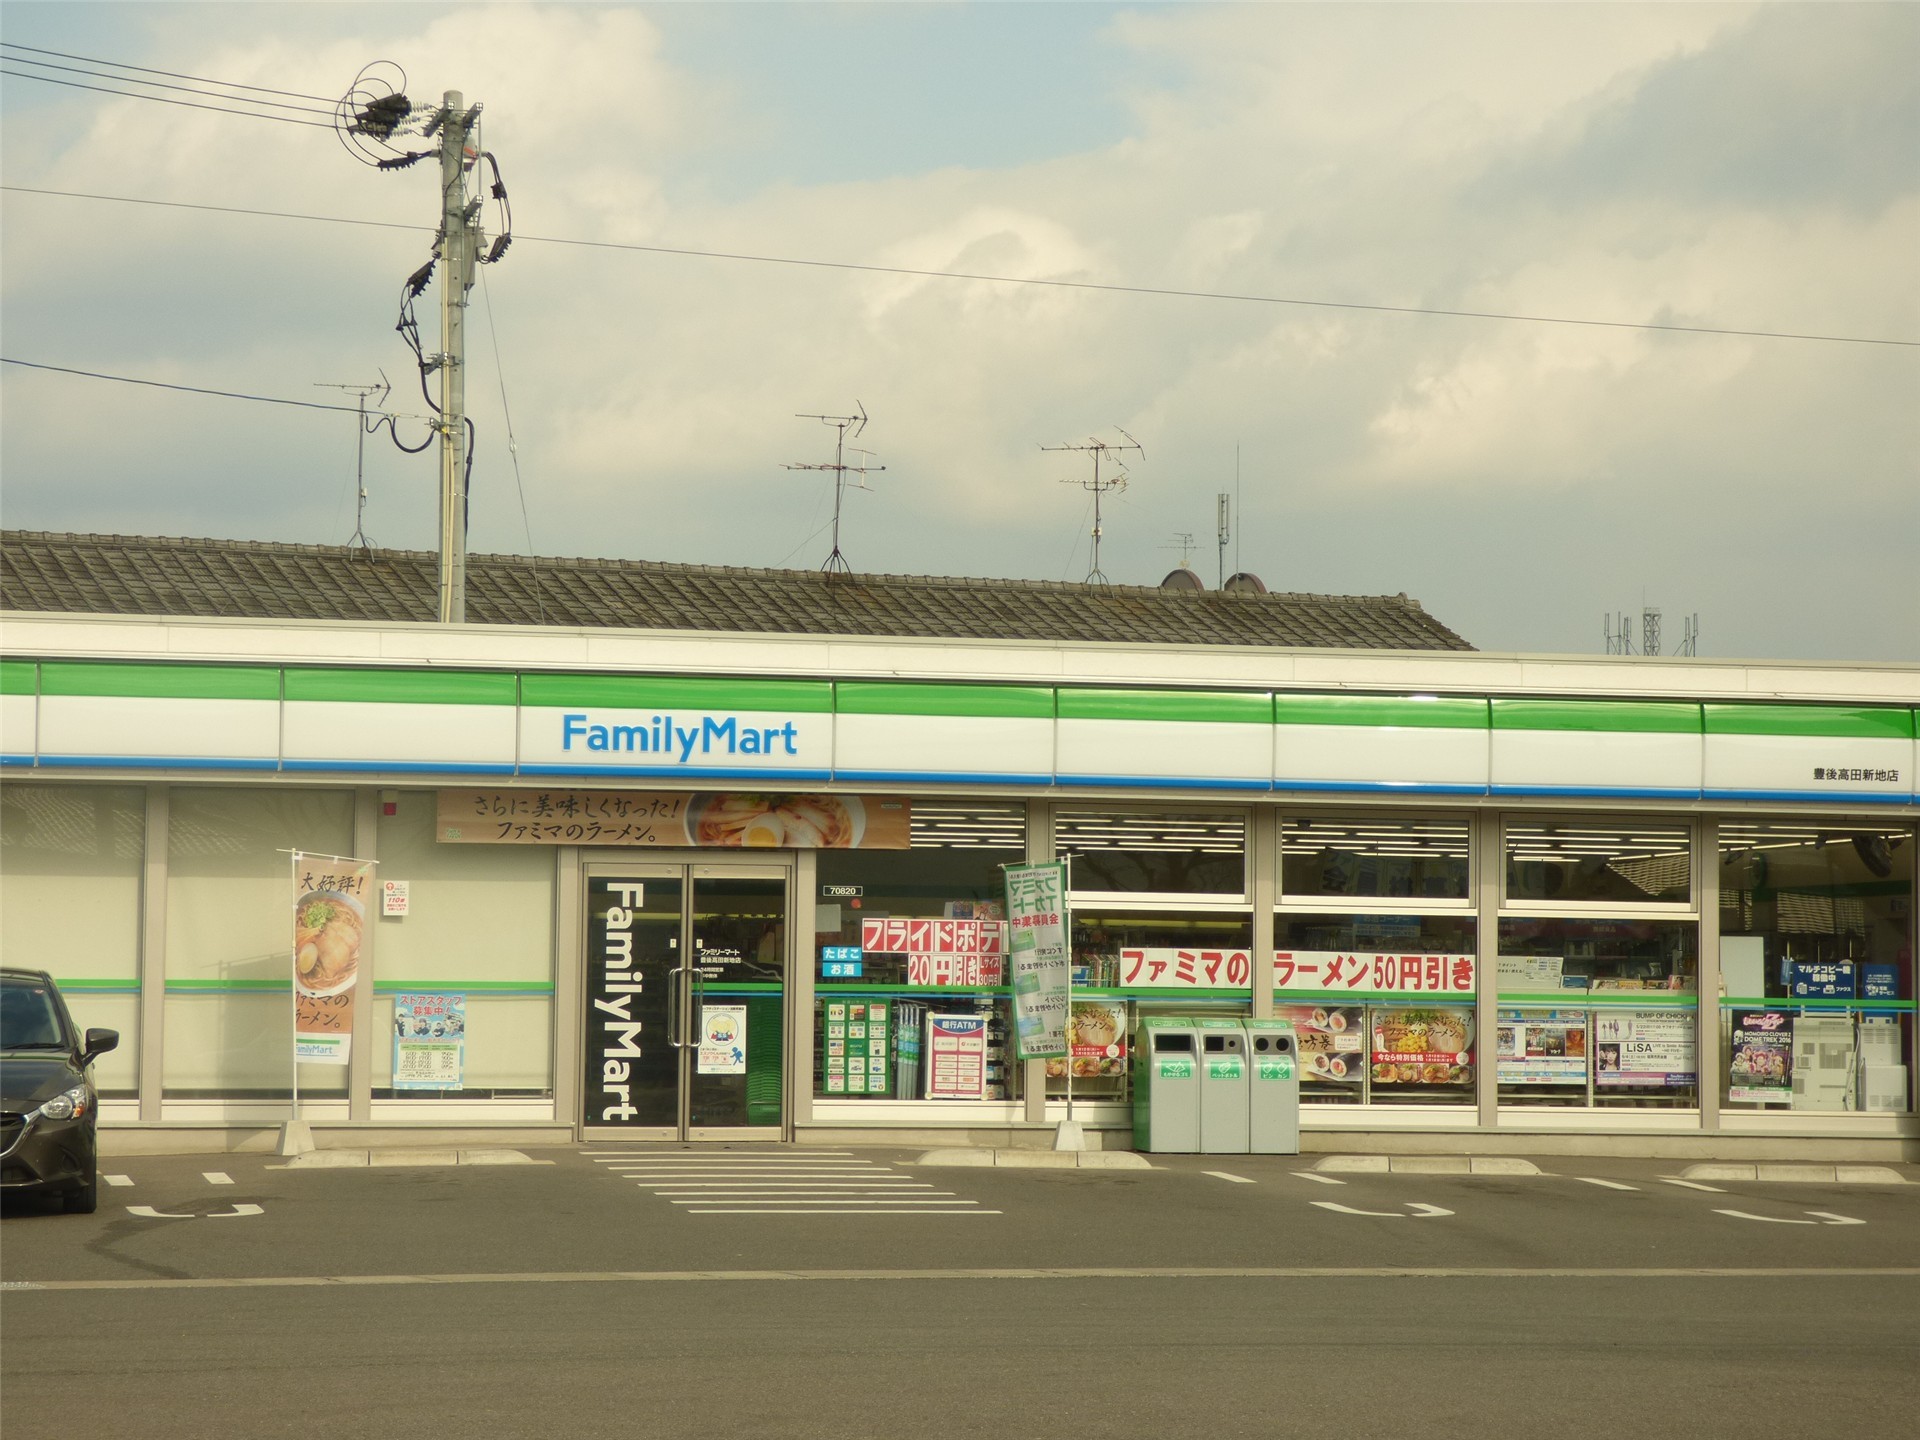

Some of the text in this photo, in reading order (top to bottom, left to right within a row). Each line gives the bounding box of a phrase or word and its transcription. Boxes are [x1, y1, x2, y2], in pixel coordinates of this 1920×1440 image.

[562, 714, 797, 762] FamilyMart
[1813, 768, 1899, 781] 豊後高田新地店
[474, 796, 680, 818] さらに美味しくなった!
[497, 822, 656, 842] ファミマのラーメン。
[301, 872, 363, 894] 大好評!
[830, 887, 856, 895] 70820
[864, 920, 1009, 952] フライドポテ
[825, 948, 859, 958] たばこ
[980, 957, 999, 968] Lサイズ
[831, 964, 854, 975] お酒
[909, 955, 978, 985] 20円引き
[1122, 951, 1474, 991] ファミマの ラーメン50円引き
[401, 995, 462, 1004] ストアスタッフ
[594, 883, 643, 1120] FamilyMart
[413, 1006, 450, 1016] 募集中!
[941, 1020, 977, 1030] 銀行ATM
[1626, 1043, 1652, 1052] LiSA
